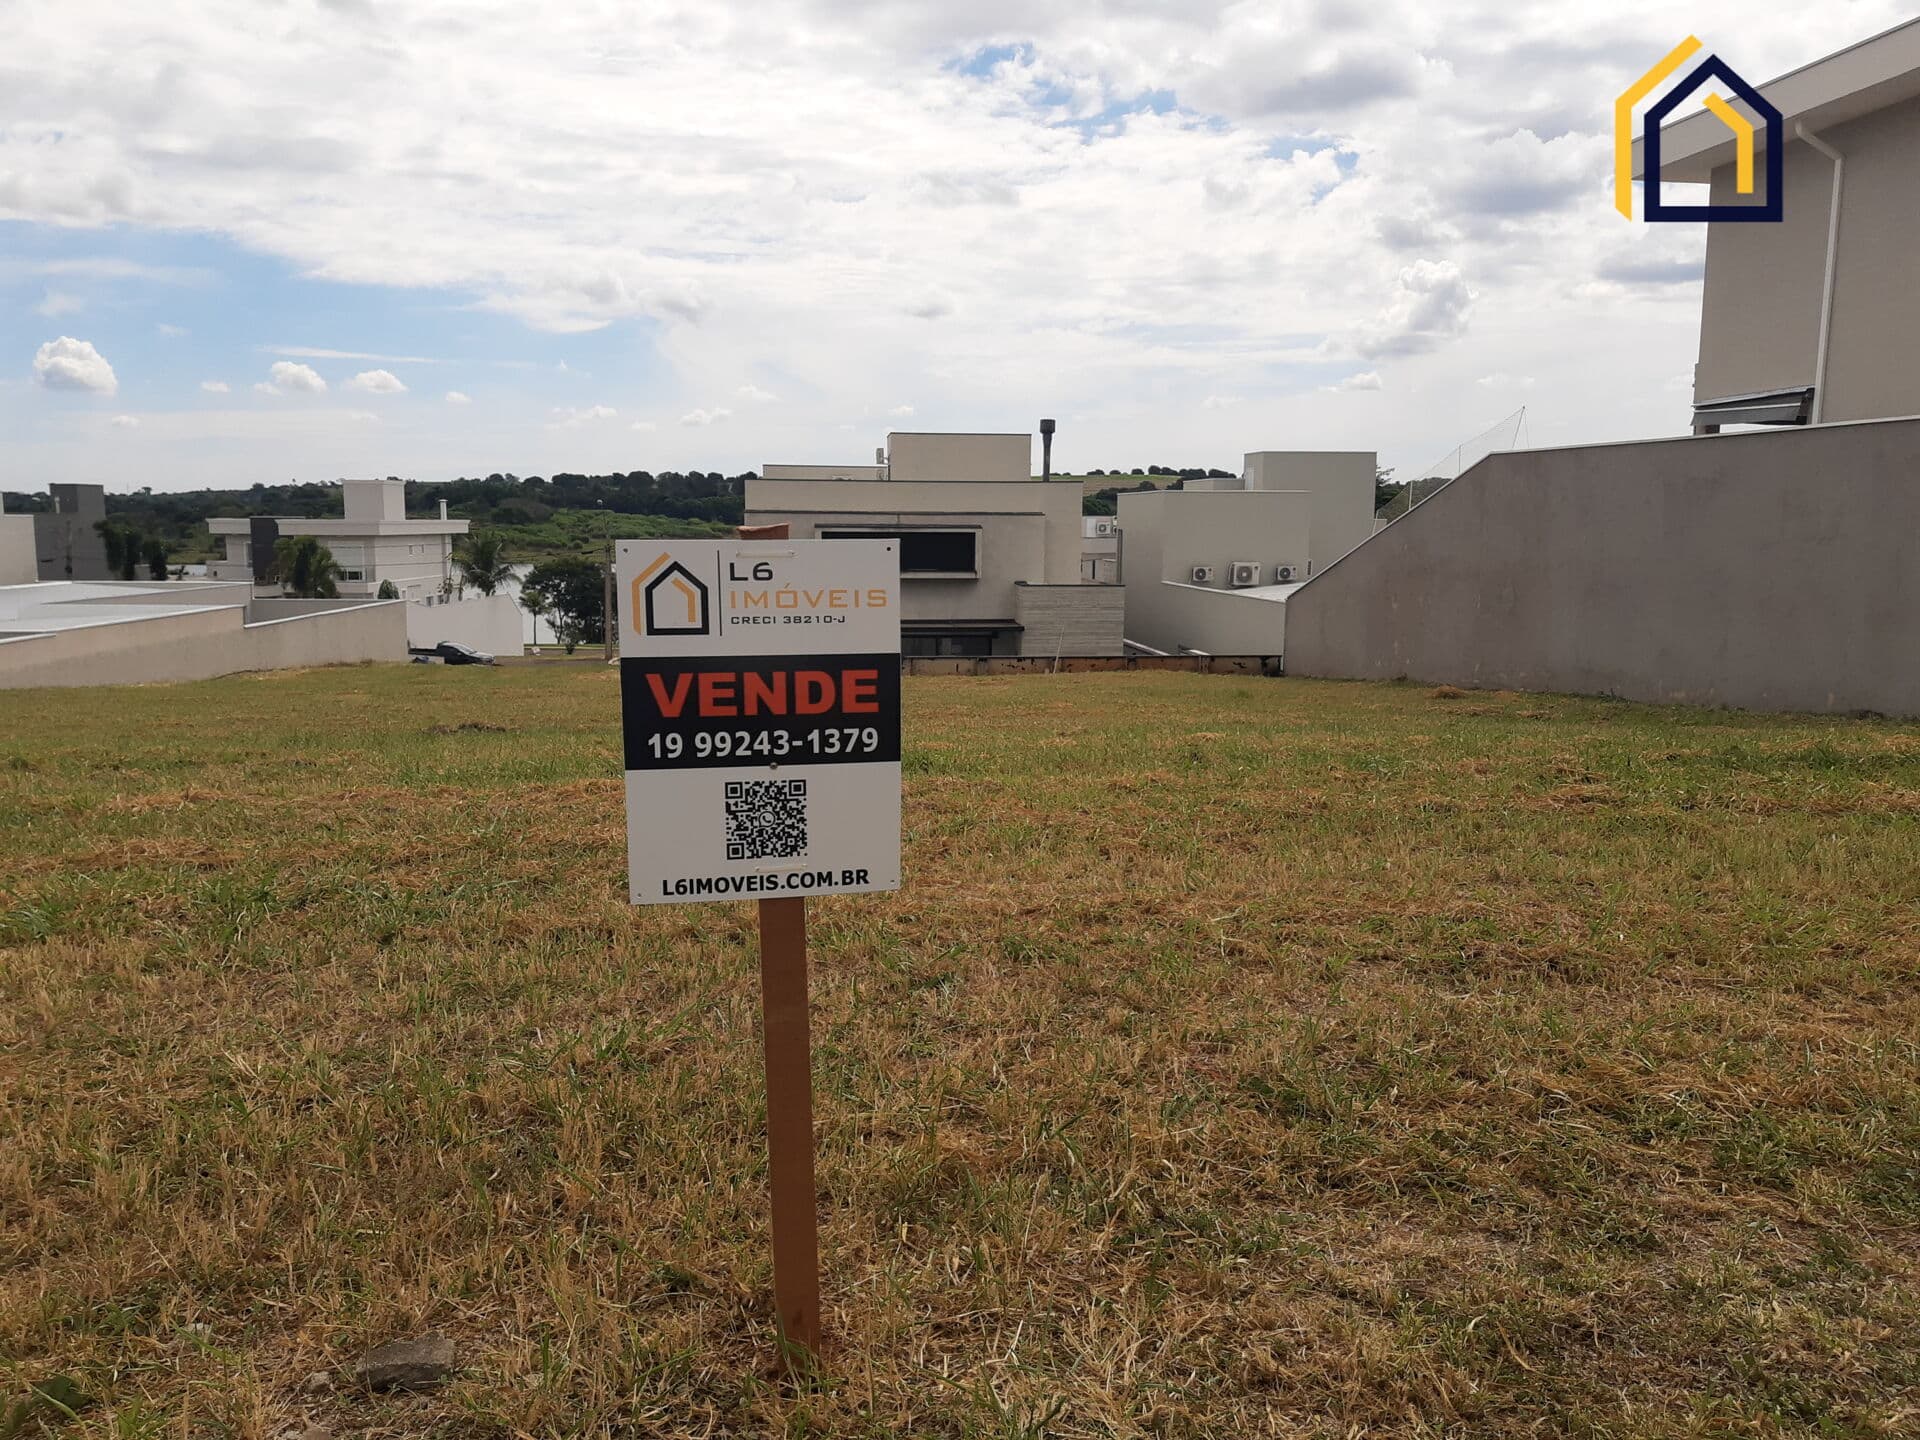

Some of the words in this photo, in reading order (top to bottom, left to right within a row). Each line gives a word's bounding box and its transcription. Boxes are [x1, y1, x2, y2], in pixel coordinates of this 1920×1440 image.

[729, 561, 774, 582] L6
[729, 583, 888, 609] IMÓVEIS
[730, 615, 777, 625] CRECI
[782, 614, 846, 625] 38210-J
[645, 669, 880, 718] VENDE
[647, 732, 684, 759] 19
[694, 727, 879, 758] 99243-1379
[662, 868, 870, 896] L6IMOVEIS.COM.BR
